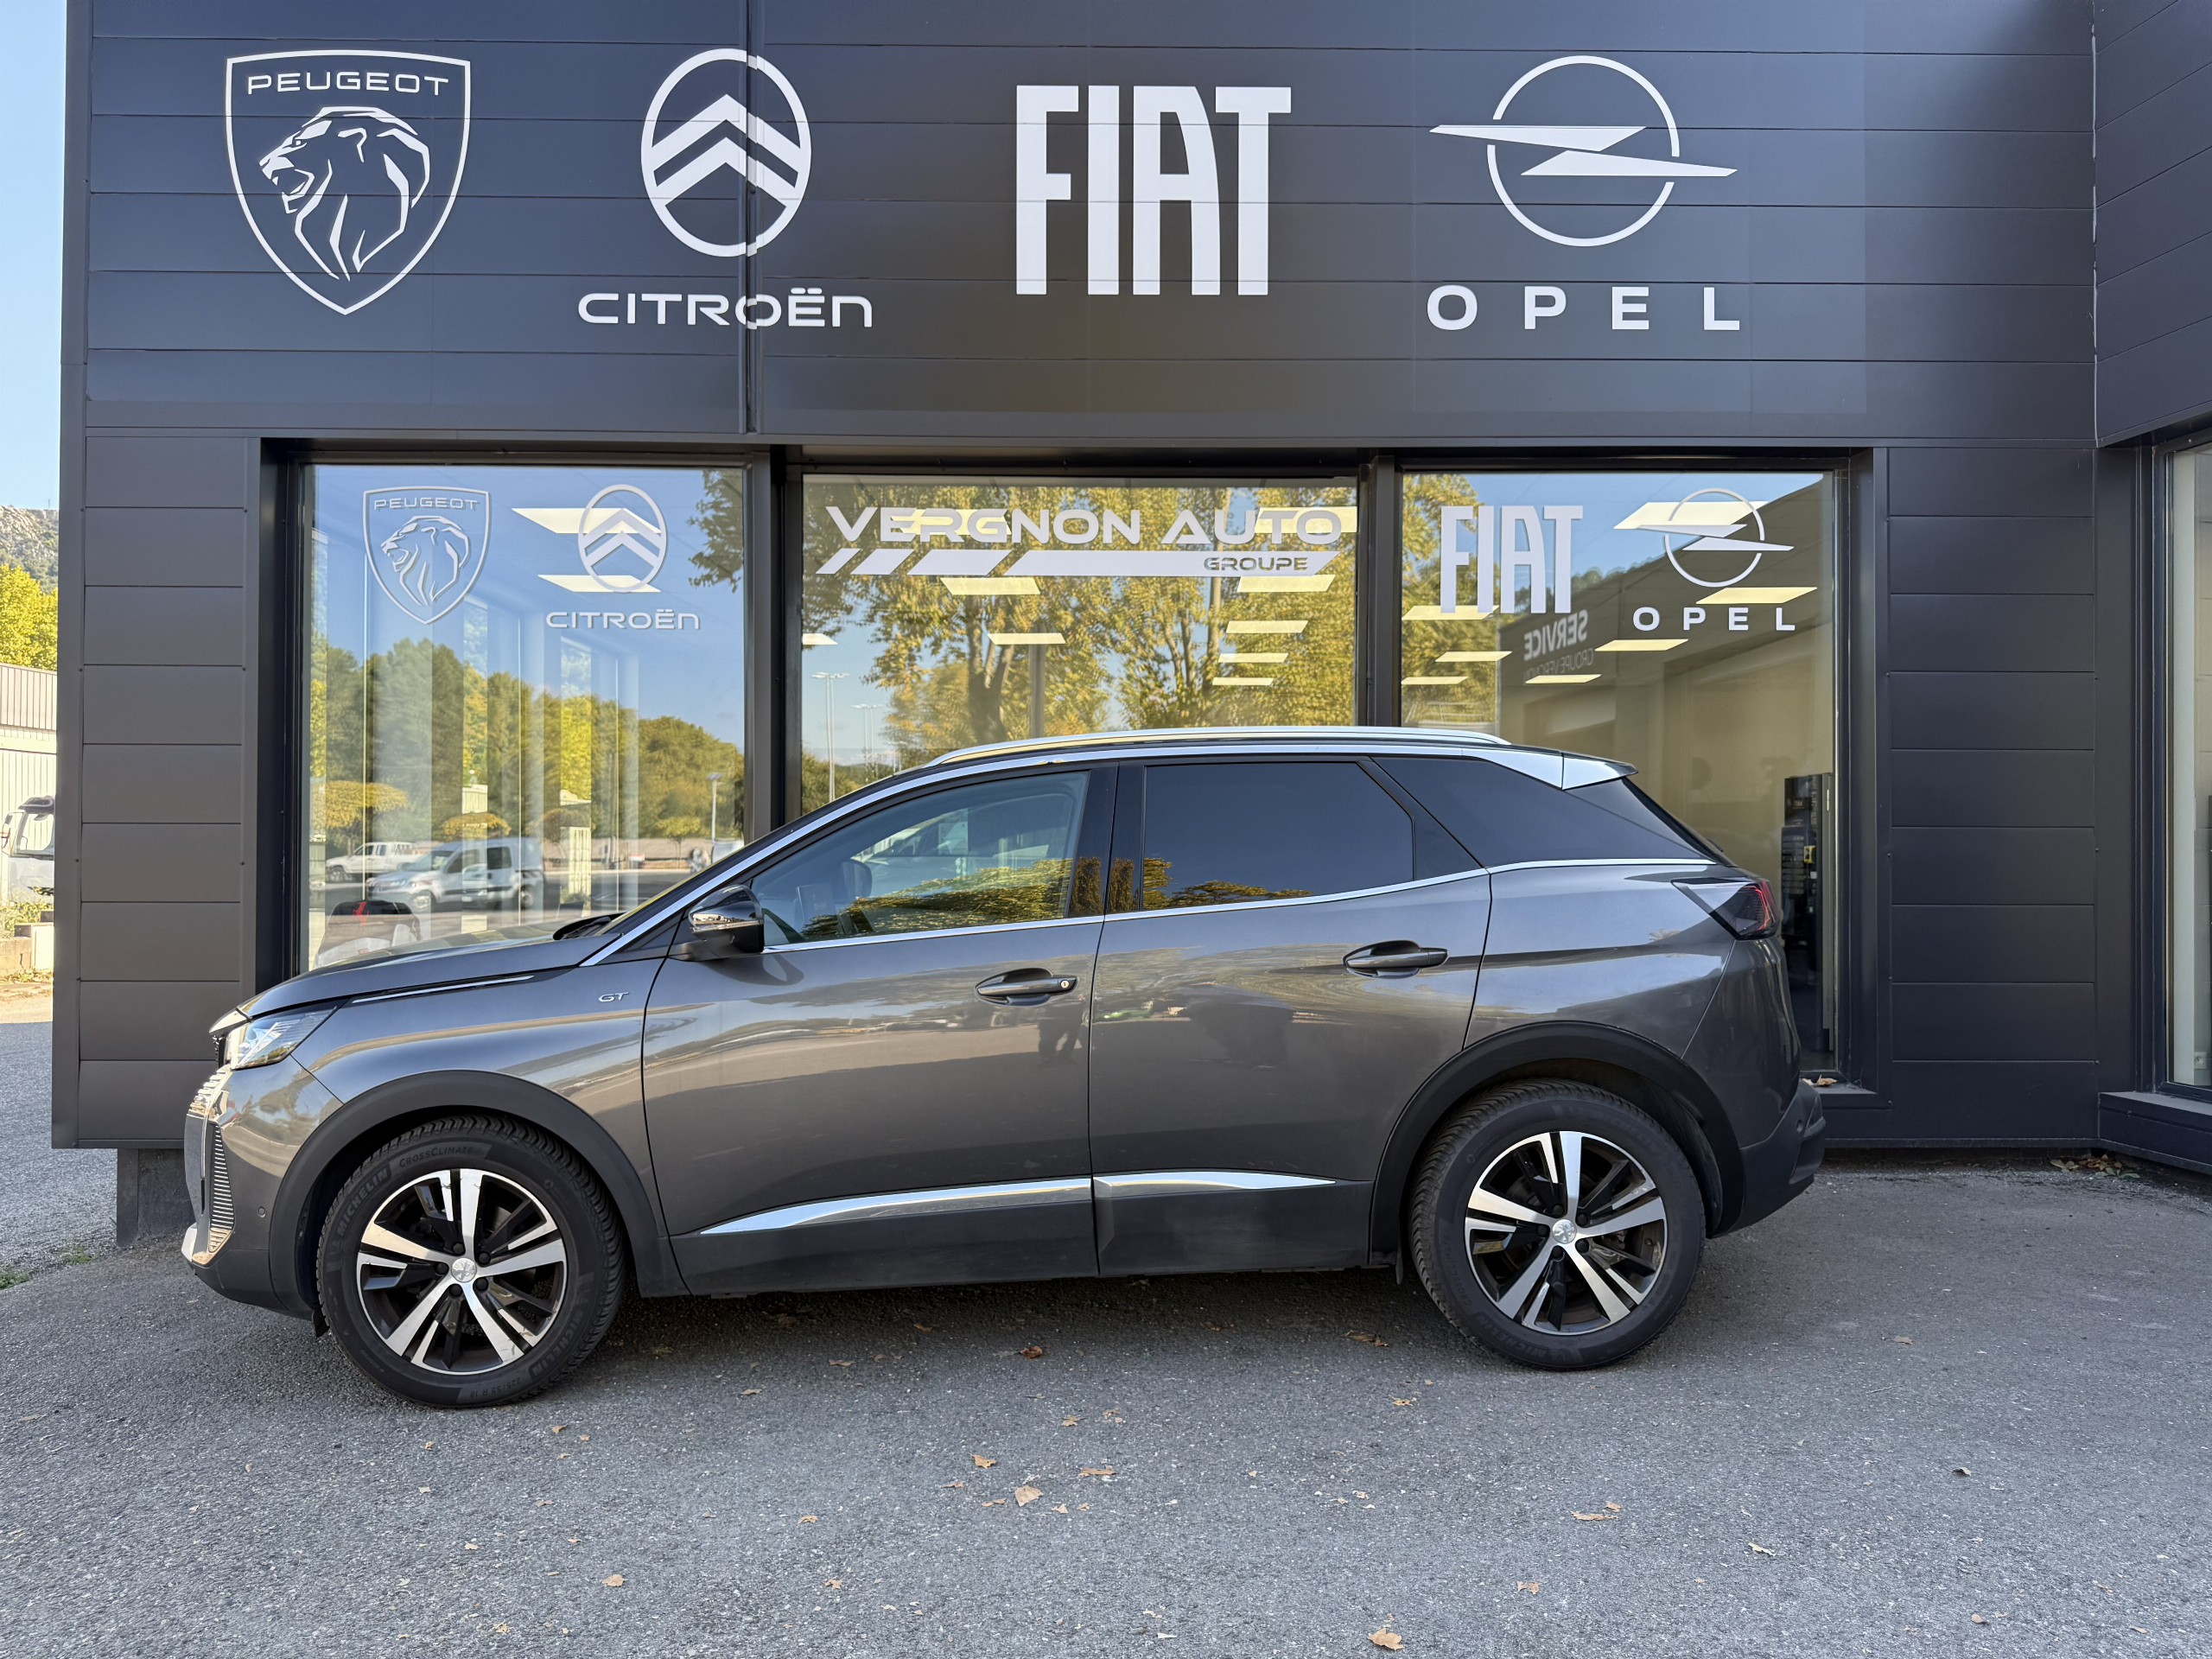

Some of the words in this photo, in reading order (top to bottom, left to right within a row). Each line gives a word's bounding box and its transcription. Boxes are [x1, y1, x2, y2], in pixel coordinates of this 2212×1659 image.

[246, 71, 449, 97] PEUGEOT
[1016, 85, 1292, 296] FIAT
[577, 287, 874, 330] CITROËN
[1427, 284, 1740, 331] OPEL
[374, 497, 479, 512] PEUGEOT
[825, 505, 1141, 544] VERGNON
[1160, 508, 1343, 545] AUTO
[1203, 556, 1309, 572] GROUPE
[1440, 505, 1584, 614] FIAT
[545, 609, 701, 630] CITROËN
[1632, 607, 1796, 632] OPEL
[598, 991, 630, 1002] GT
[336, 1168, 390, 1236] MICHELIN
